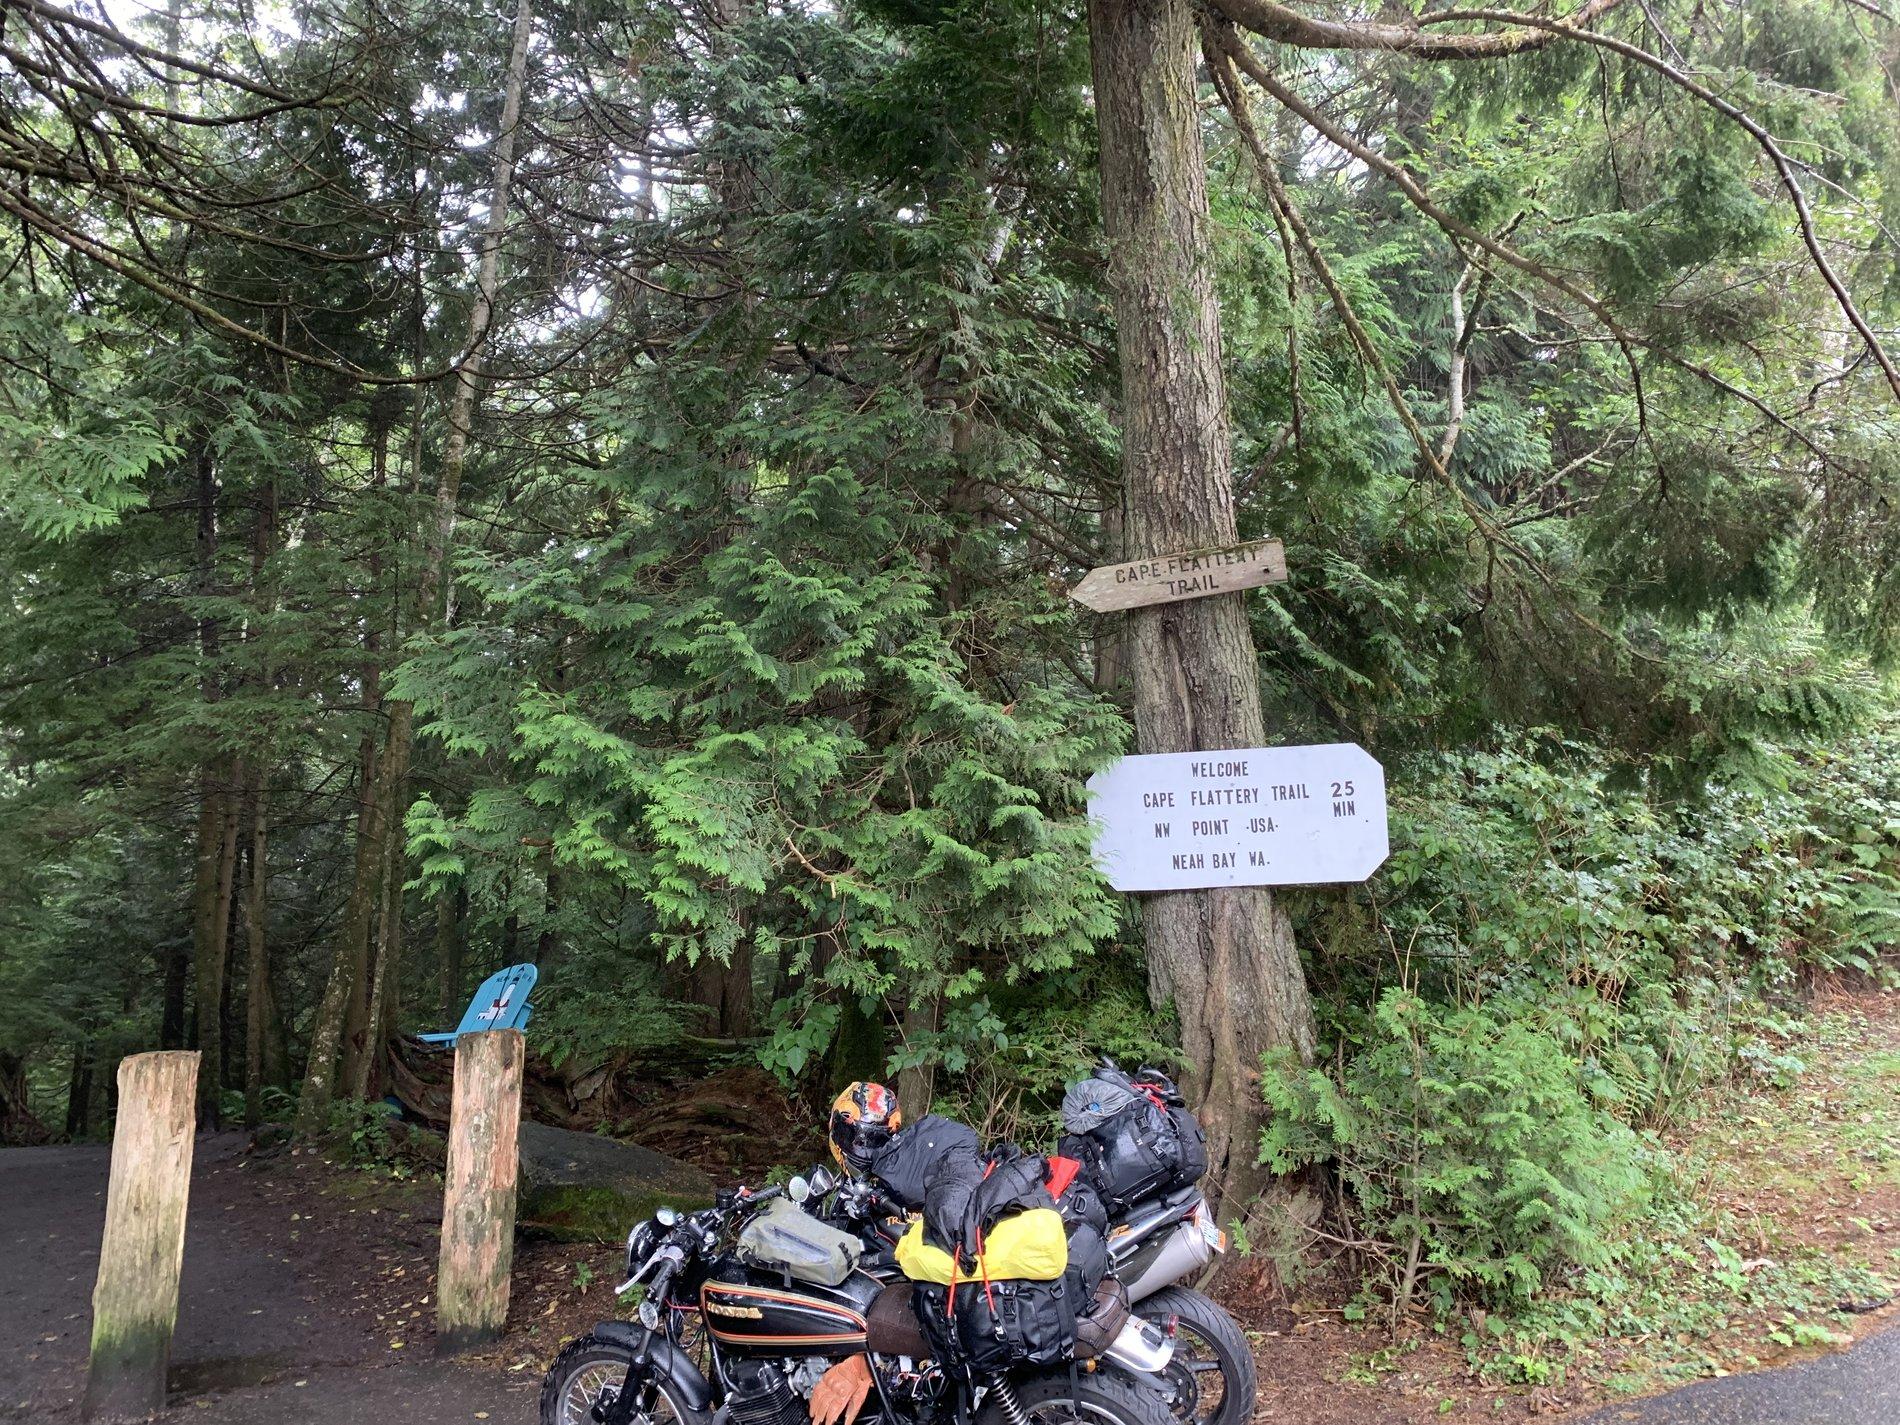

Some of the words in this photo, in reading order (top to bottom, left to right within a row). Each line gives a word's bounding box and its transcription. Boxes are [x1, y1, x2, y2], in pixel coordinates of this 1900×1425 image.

[1115, 561, 1161, 584] CAPE
[1167, 574, 1219, 596] TRAIL
[1191, 761, 1249, 778] WELCOME
[1143, 792, 1175, 808] CAPE
[1191, 787, 1258, 807] FLATTERY
[1271, 783, 1310, 801] TRAIL
[1330, 780, 1355, 798] 25
[1332, 800, 1356, 817] MIN
[1154, 822, 1170, 838] NW
[1192, 819, 1229, 836] POINT
[1172, 853, 1205, 870] NEAH
[1212, 852, 1236, 869] BAY
